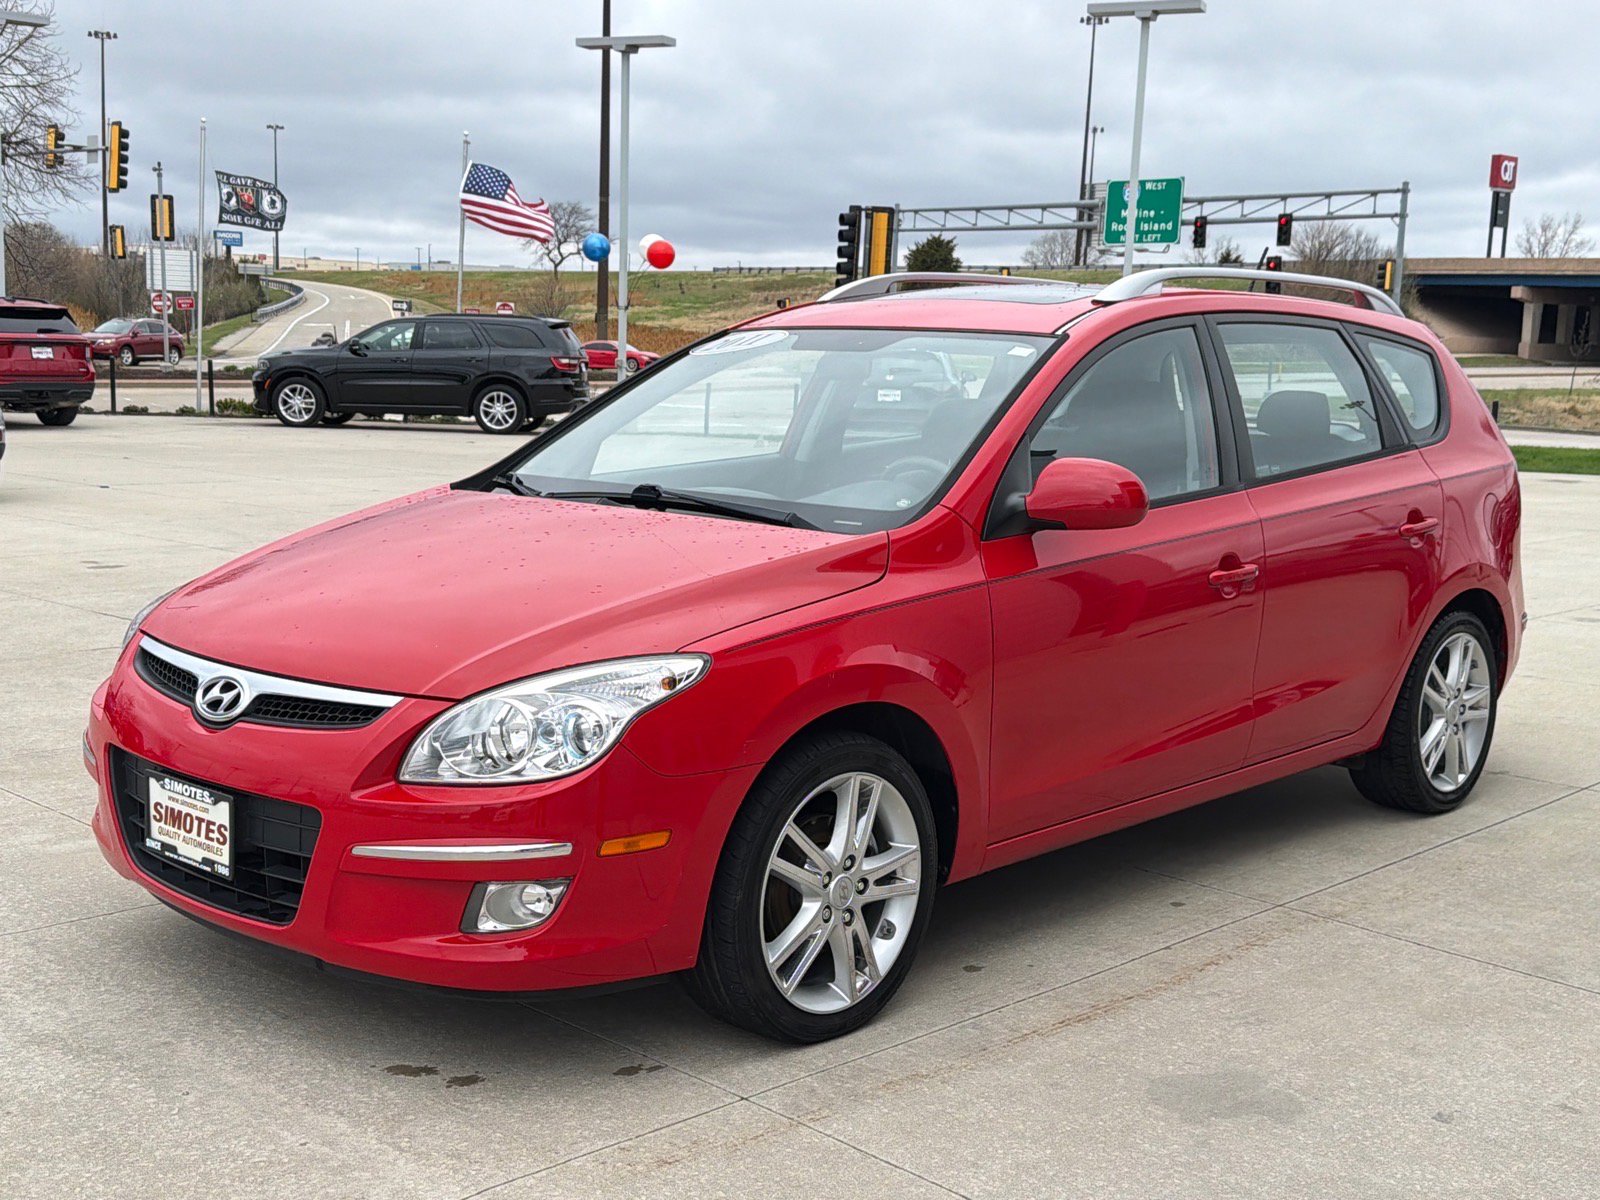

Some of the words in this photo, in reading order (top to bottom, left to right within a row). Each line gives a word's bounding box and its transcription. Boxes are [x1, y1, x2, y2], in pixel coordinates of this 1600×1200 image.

[1501, 160, 1516, 183] QT
[229, 176, 253, 187] GAVE
[1145, 182, 1167, 190] WEST
[1140, 221, 1173, 231] Island
[1142, 234, 1162, 242] LEFT
[164, 778, 211, 803] SIMOTES
[152, 801, 228, 846] SIMOTES
[158, 825, 181, 841] QUALITY
[182, 835, 224, 857] AUTOMOBILES
